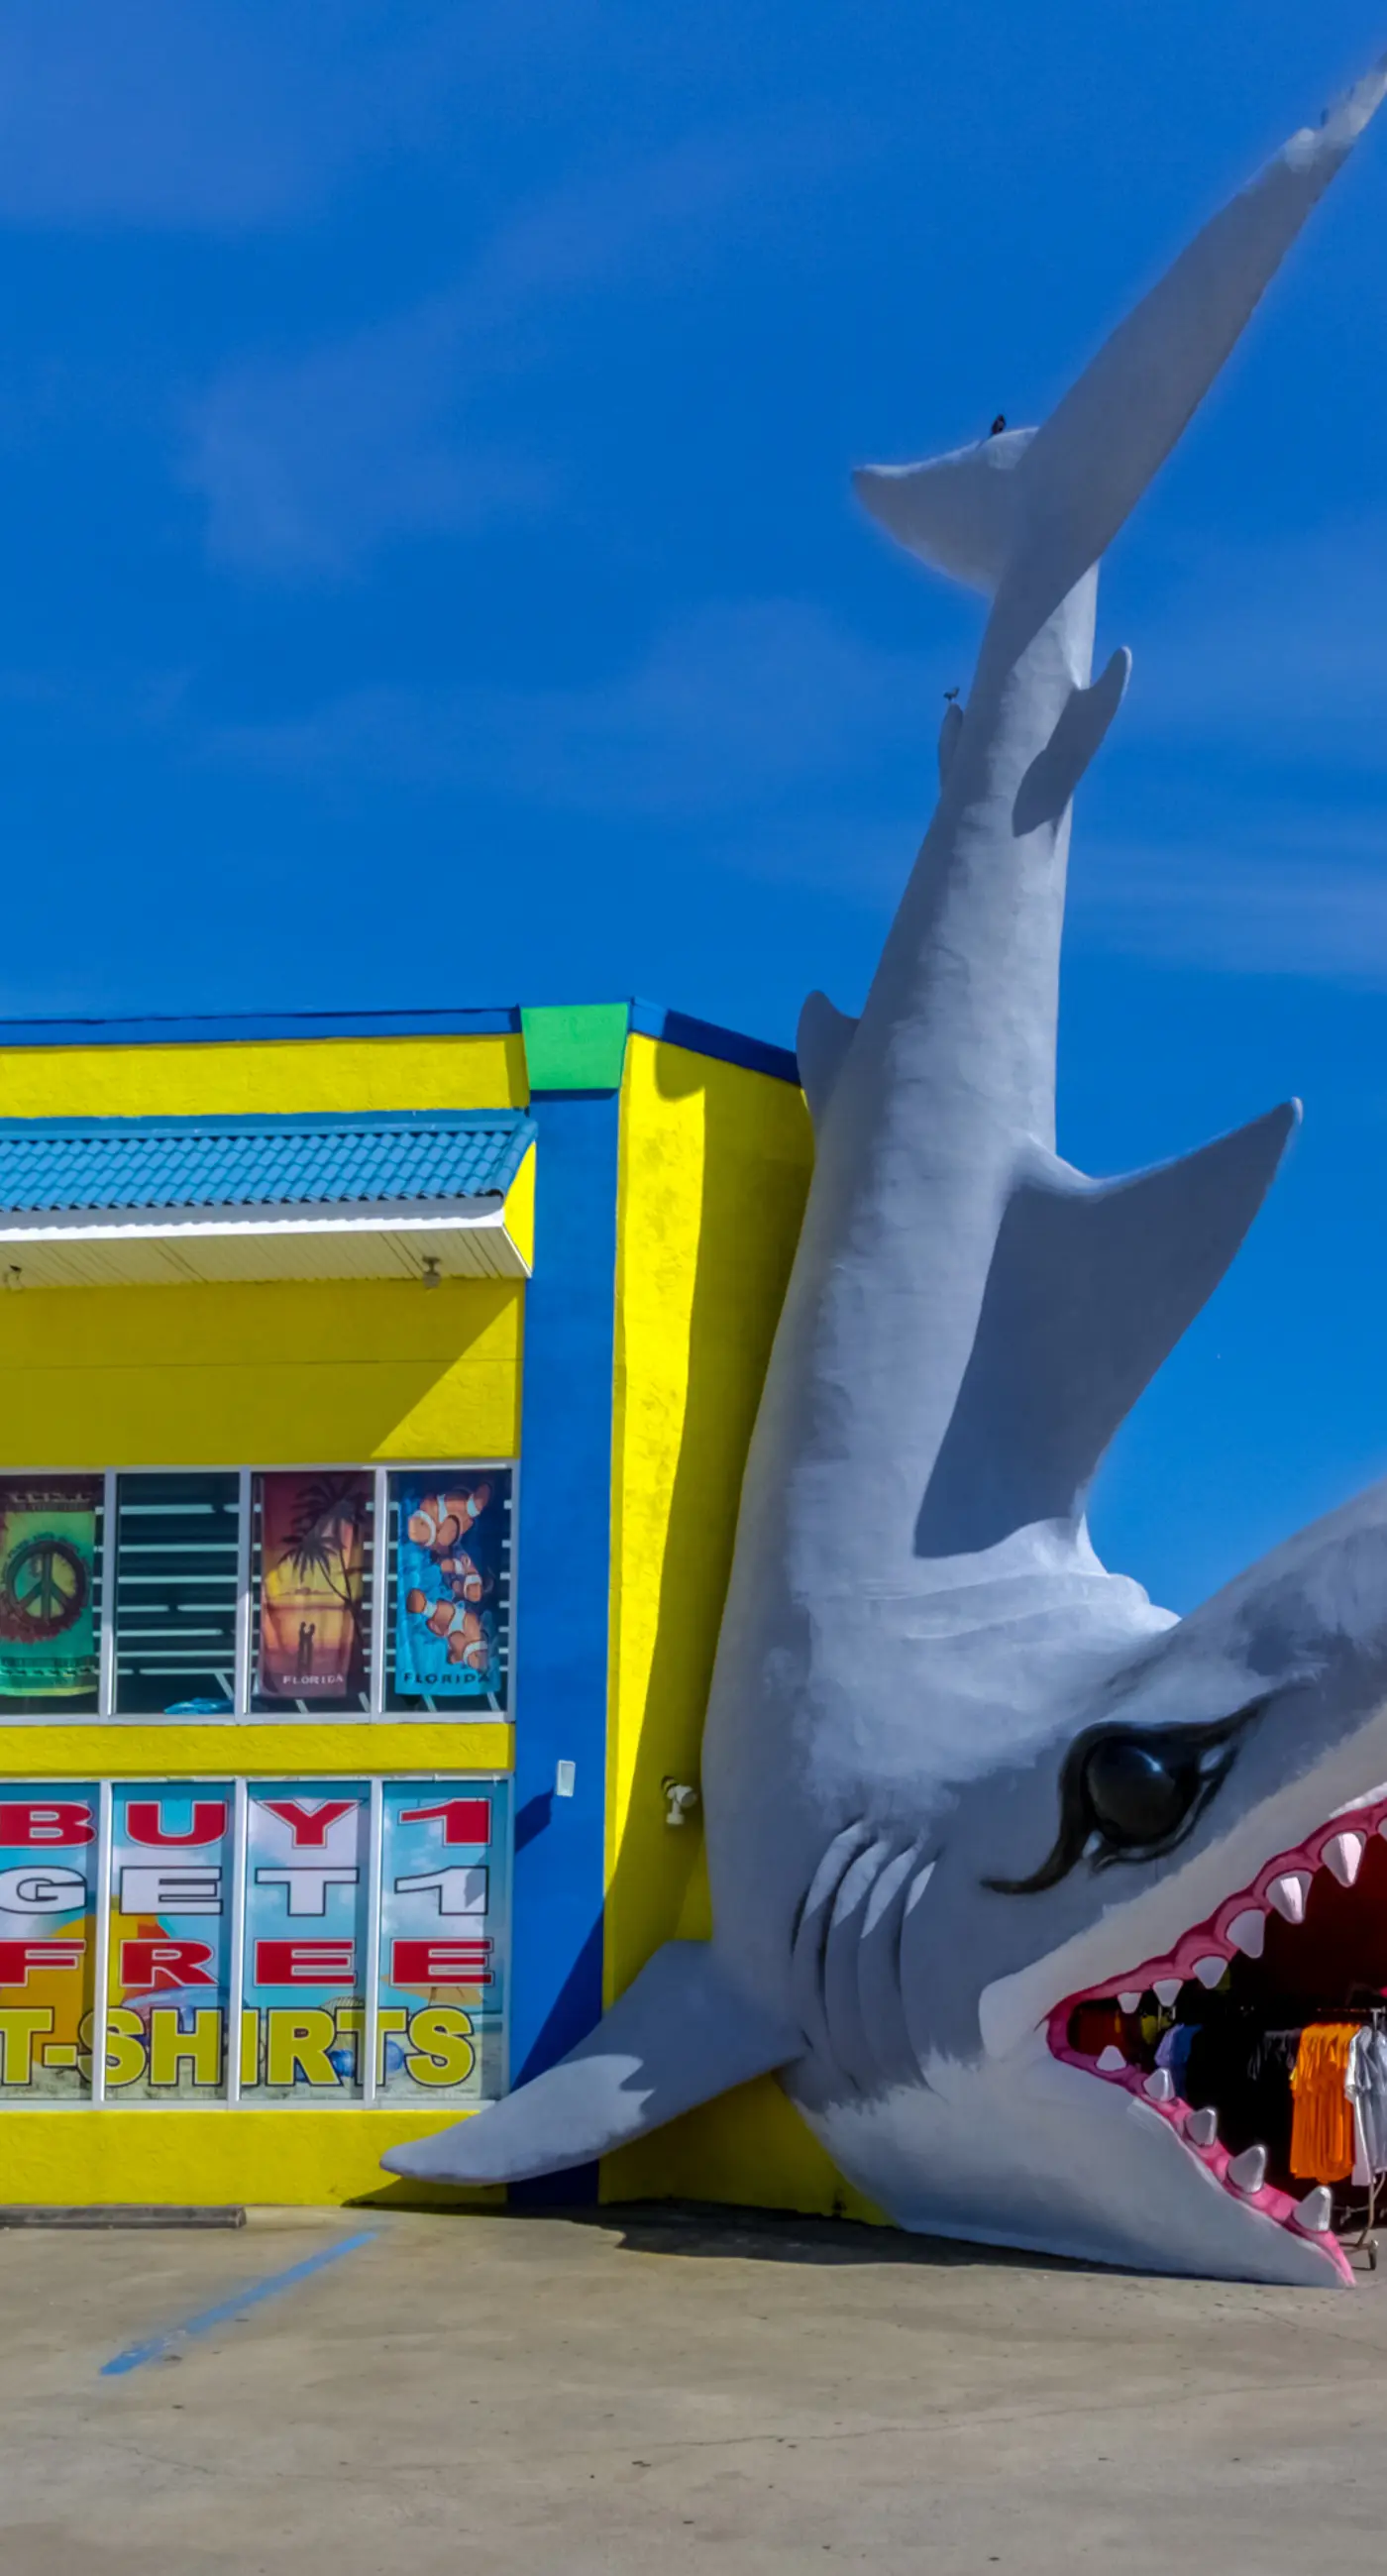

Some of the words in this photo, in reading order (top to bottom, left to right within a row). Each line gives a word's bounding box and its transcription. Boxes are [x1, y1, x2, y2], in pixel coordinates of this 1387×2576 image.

[282, 1673, 345, 1685] FLORIDA
[402, 1671, 491, 1684] FLORIDA
[0, 1798, 367, 1849] BUY
[398, 1798, 491, 1848] 1
[0, 1866, 360, 1916] GET
[395, 1865, 489, 1915] 1
[0, 1938, 495, 1987] FREE
[0, 2006, 477, 2088] T-SHIRTS
